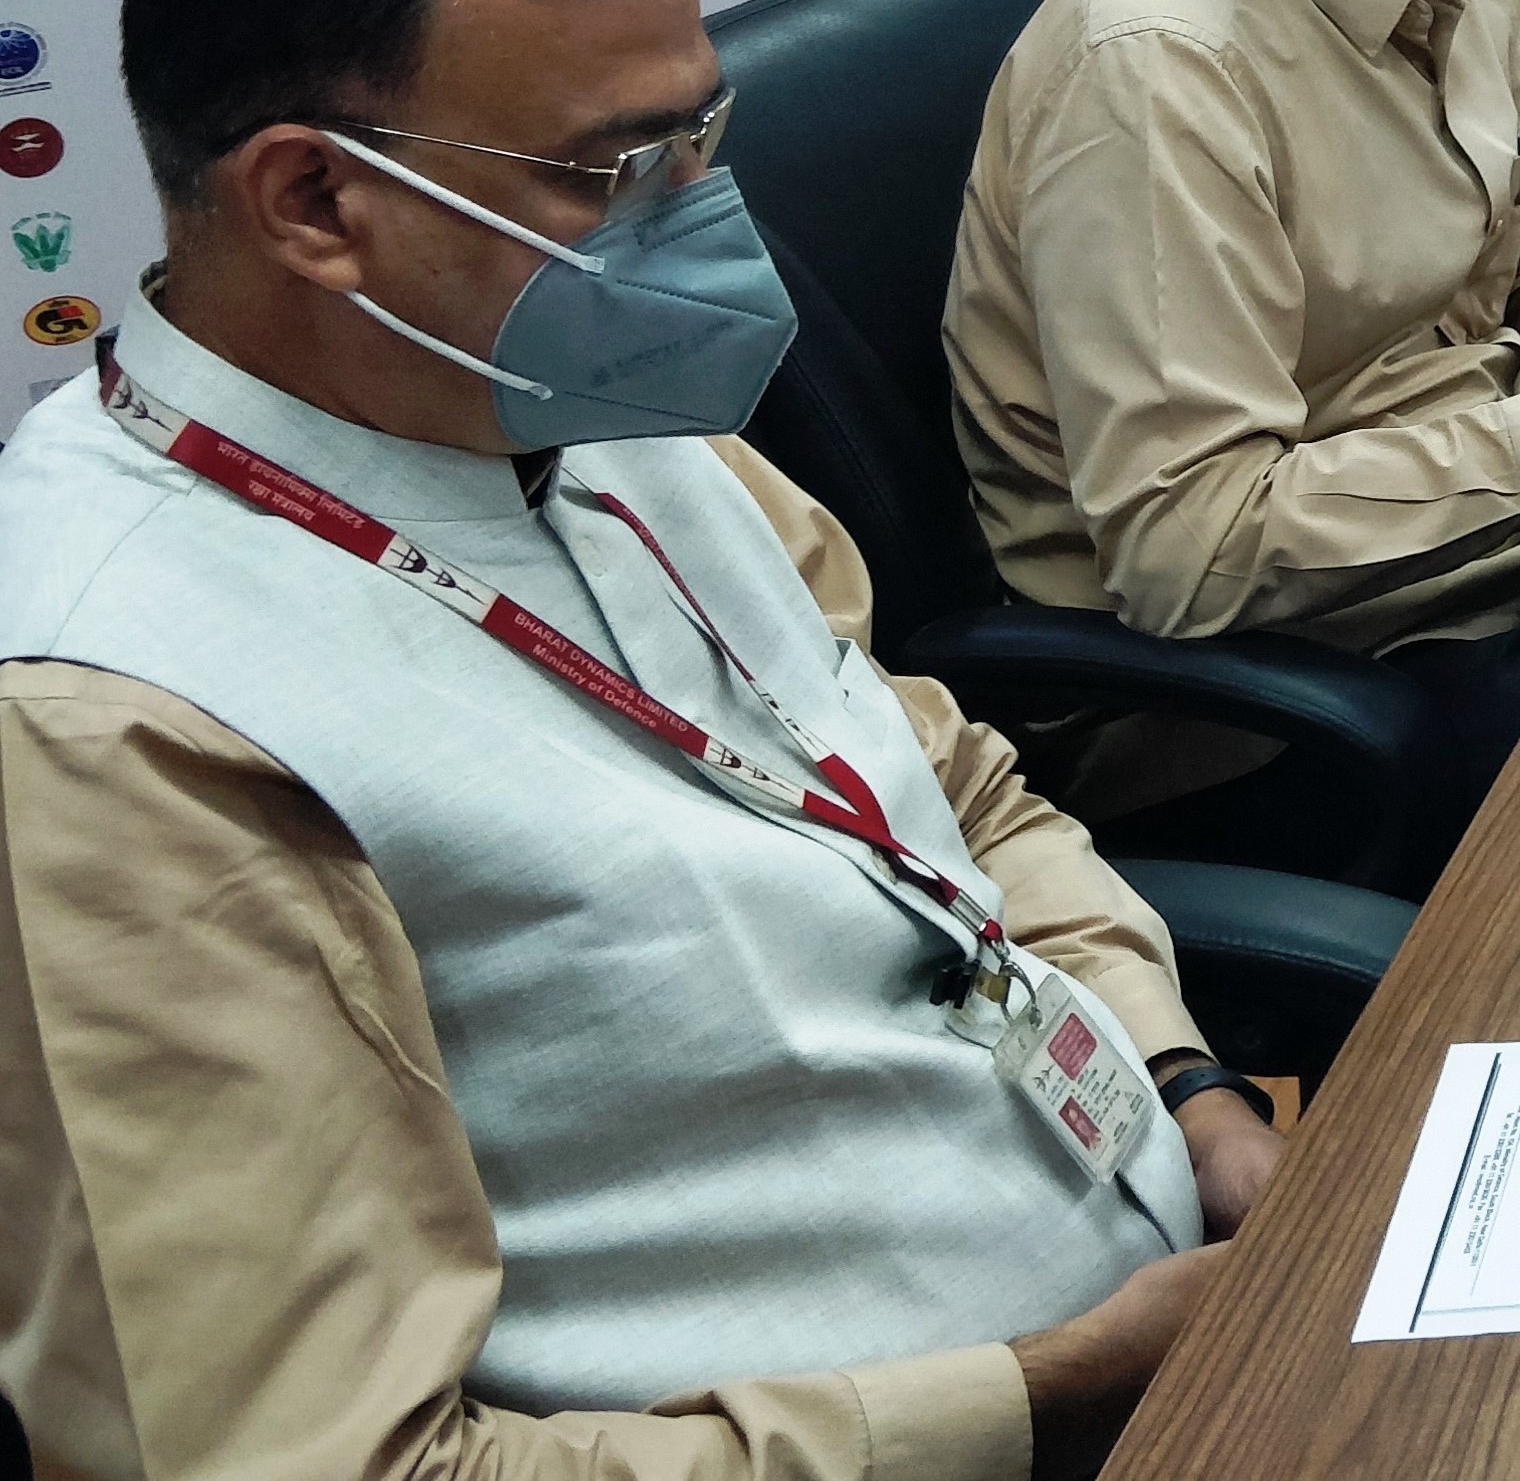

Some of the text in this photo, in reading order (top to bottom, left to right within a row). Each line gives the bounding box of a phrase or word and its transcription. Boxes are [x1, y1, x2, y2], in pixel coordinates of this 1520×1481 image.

[514, 612, 689, 733] BHARAT DYNAMICS LIMITED
[532, 643, 658, 729] Ministry of Defence
